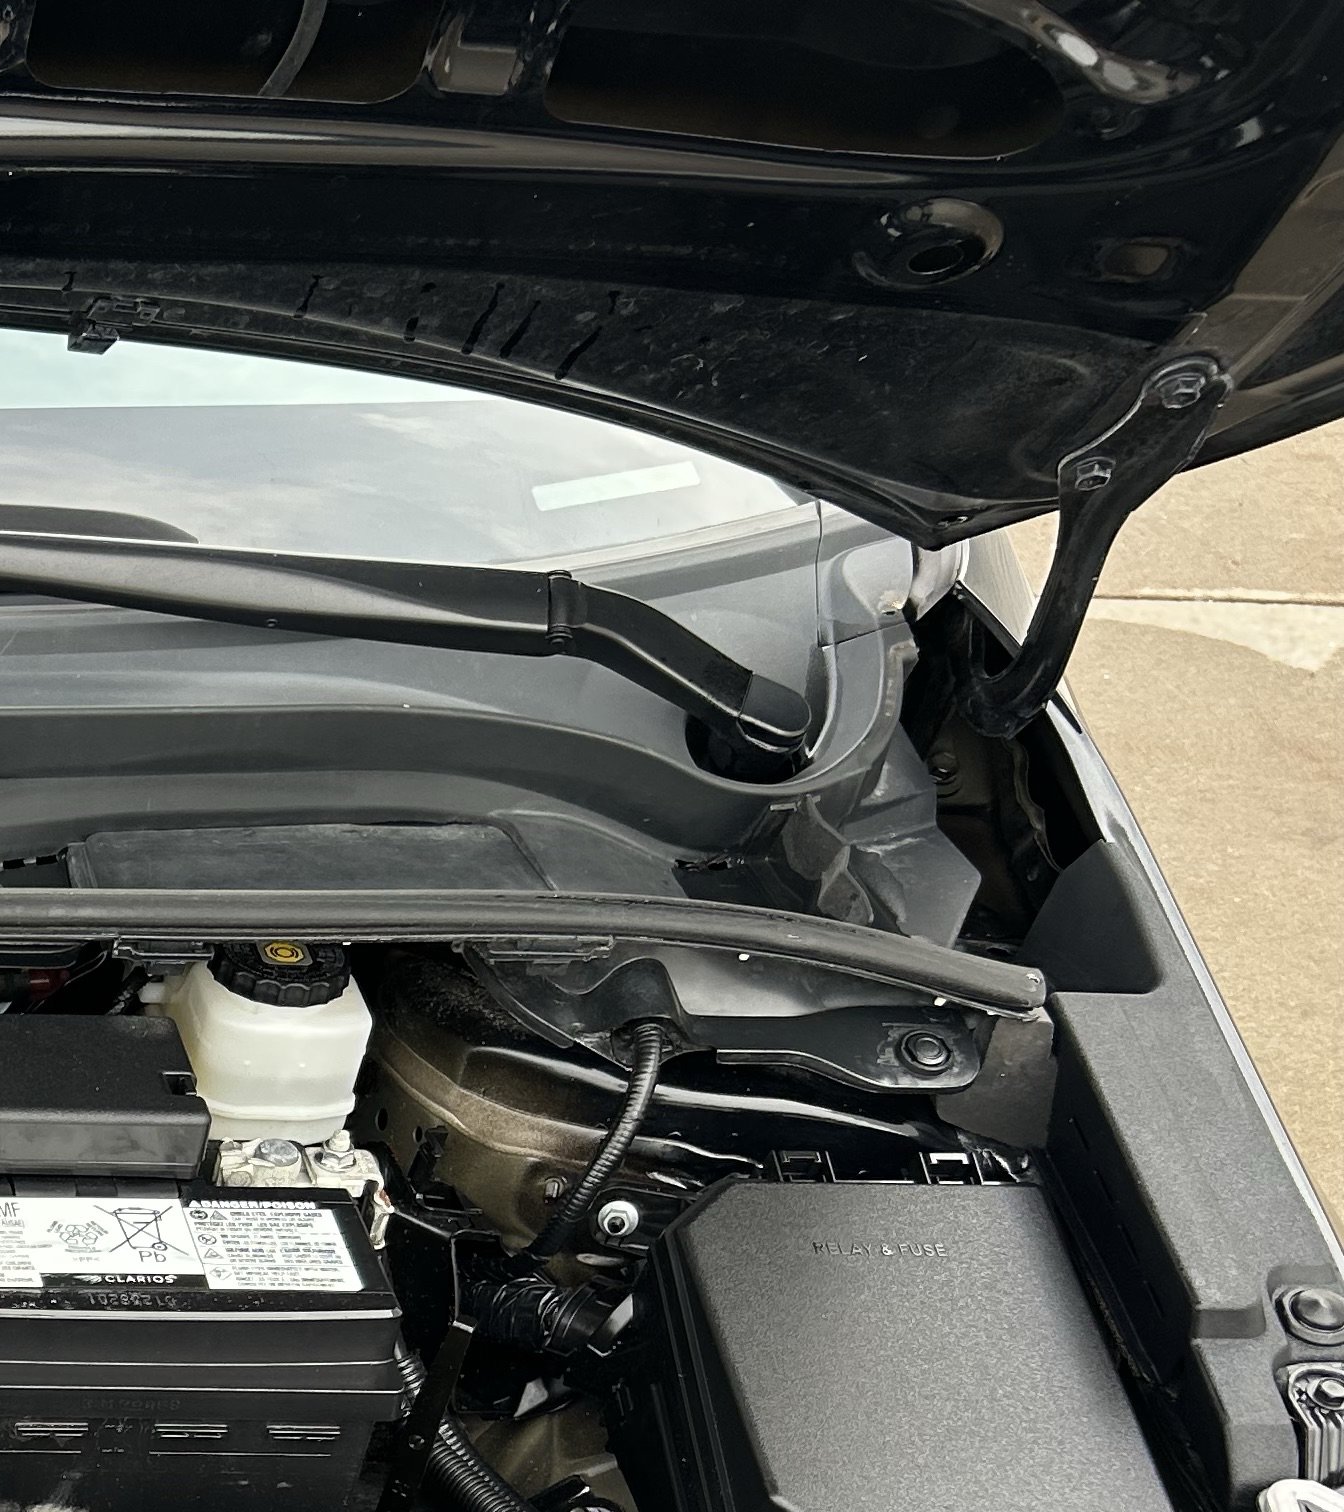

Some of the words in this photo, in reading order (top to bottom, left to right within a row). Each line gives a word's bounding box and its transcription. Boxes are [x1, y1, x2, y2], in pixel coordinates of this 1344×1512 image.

[812, 1241, 872, 1256] RELAY
[880, 1242, 894, 1256] &
[897, 1242, 948, 1257] FUSE
[139, 1250, 166, 1263] Pb
[105, 1274, 178, 1284] CLARIOS
